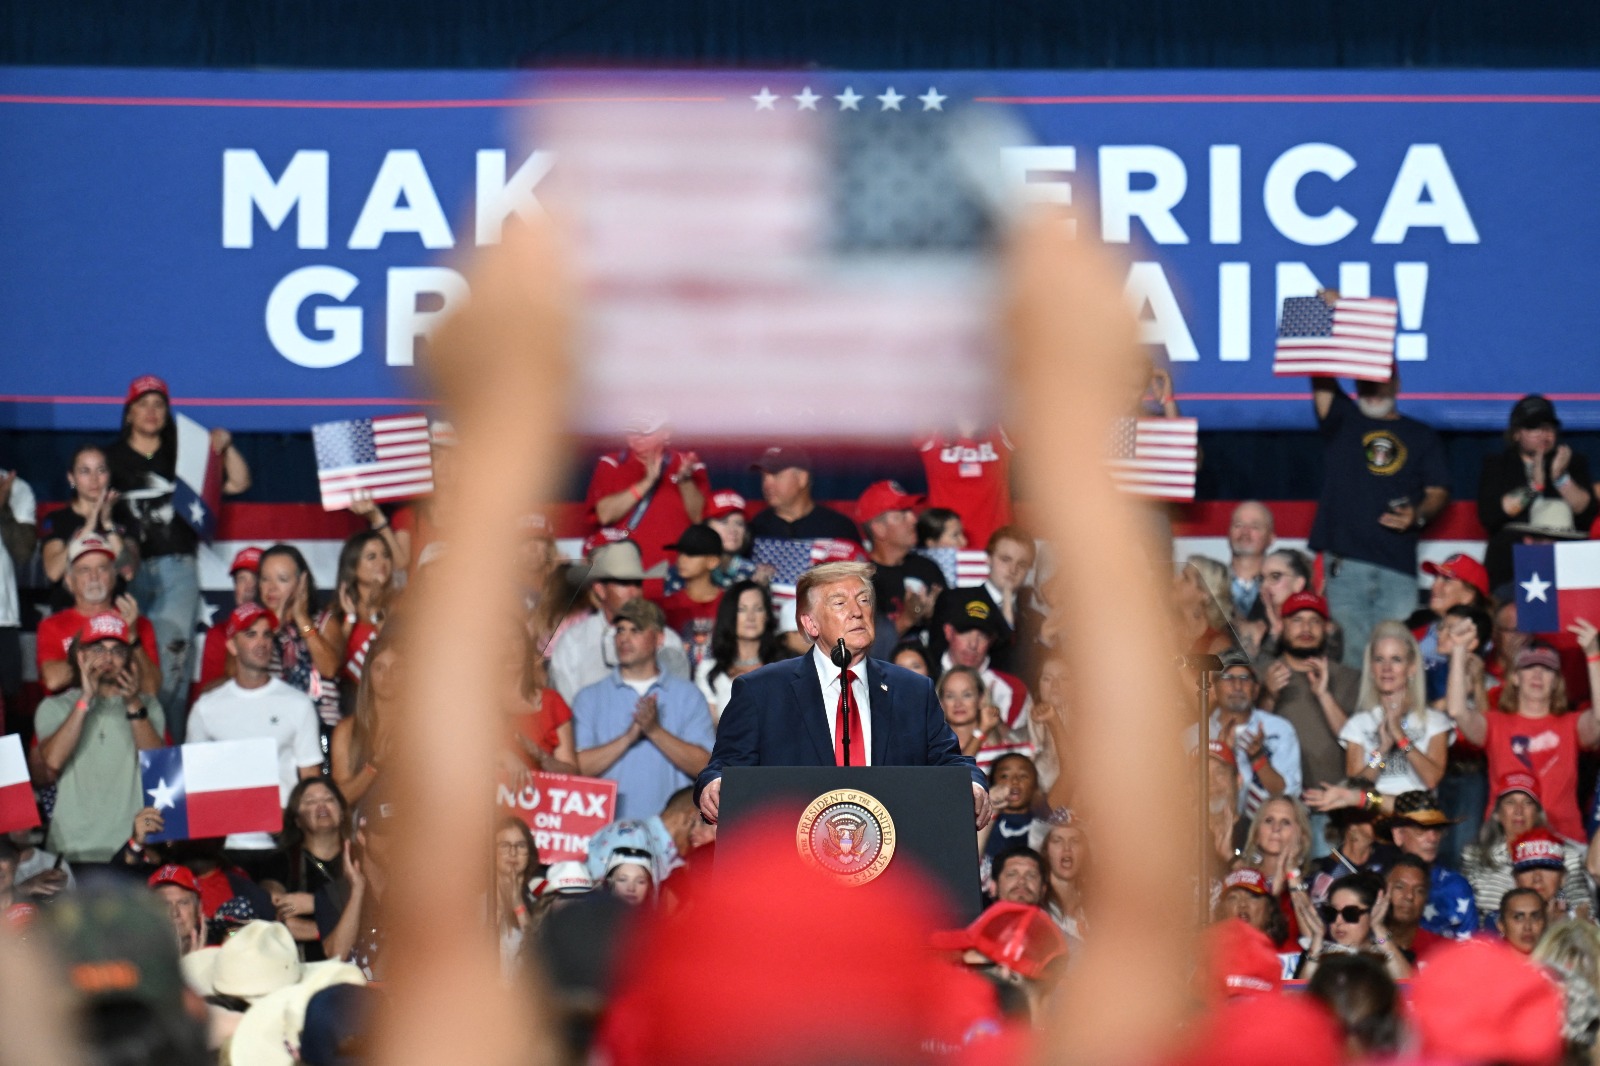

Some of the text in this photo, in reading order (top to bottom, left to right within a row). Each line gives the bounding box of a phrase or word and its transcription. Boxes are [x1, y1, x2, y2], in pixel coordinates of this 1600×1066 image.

[222, 143, 1480, 249] MAK ERICA
[496, 783, 608, 818] NO TAX
[847, 793, 857, 801] OF
[858, 796, 872, 807] THE
[534, 812, 562, 829] ON
[800, 792, 845, 835] PRESIDENT
[872, 805, 893, 846] UNITED
[532, 829, 590, 854] RTIM
[853, 854, 888, 883] STATES
